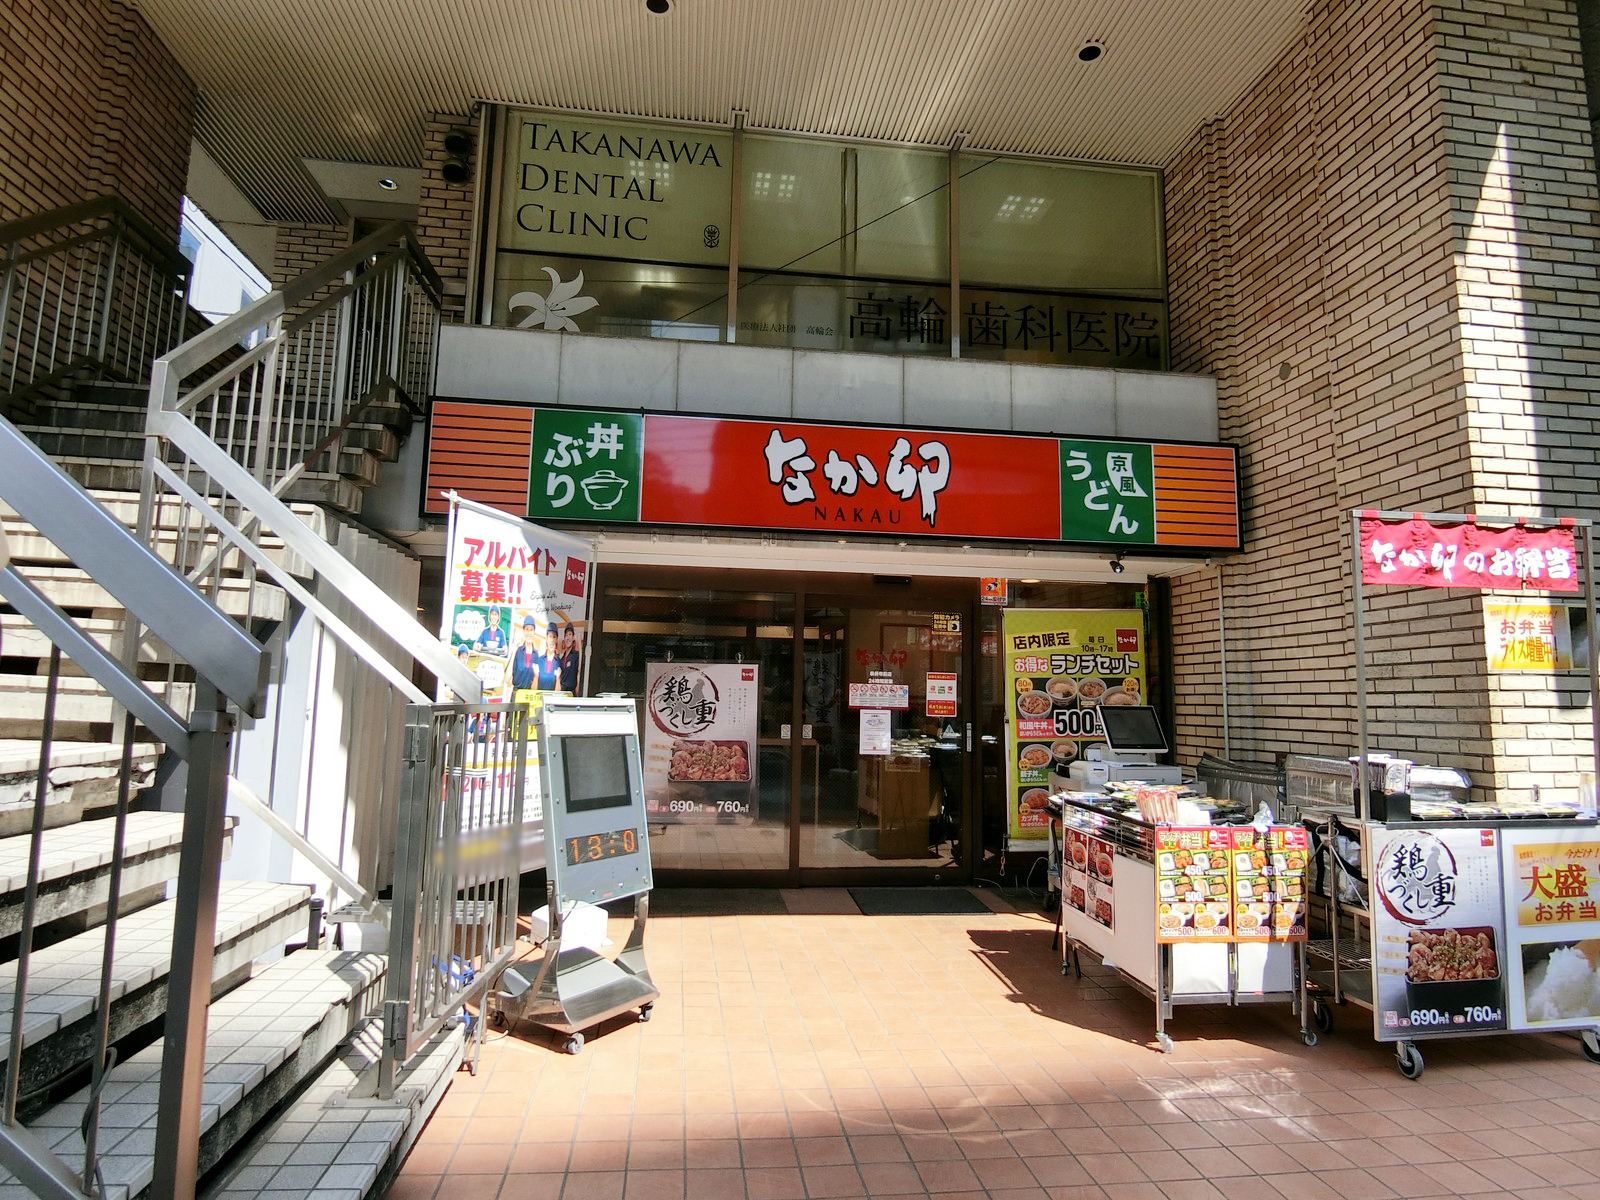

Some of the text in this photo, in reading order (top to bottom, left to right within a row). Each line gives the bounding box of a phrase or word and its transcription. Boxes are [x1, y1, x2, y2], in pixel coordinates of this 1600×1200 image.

[523, 122, 723, 167] TAKANAWA
[520, 163, 664, 203] DENTAL
[516, 203, 648, 241] CLINIC
[740, 320, 834, 337] 医療法人社団 高輪会
[846, 291, 1160, 359] 高輪歯科医院
[763, 428, 951, 528] なか卯
[1111, 455, 1137, 494] 京風
[1066, 450, 1139, 535] うどん
[814, 506, 901, 524] NAKAU
[463, 536, 557, 576] アルバイト
[566, 568, 585, 585] なか卯
[1013, 632, 1071, 650] 店内限定
[1117, 636, 1137, 644] なか卯
[1500, 619, 1553, 635] お弁当
[1014, 654, 1139, 674] お得な ランチセット
[1180, 831, 1203, 848] 弁当
[1520, 863, 1589, 902] 大盛
[1535, 900, 1597, 922] お弁当
